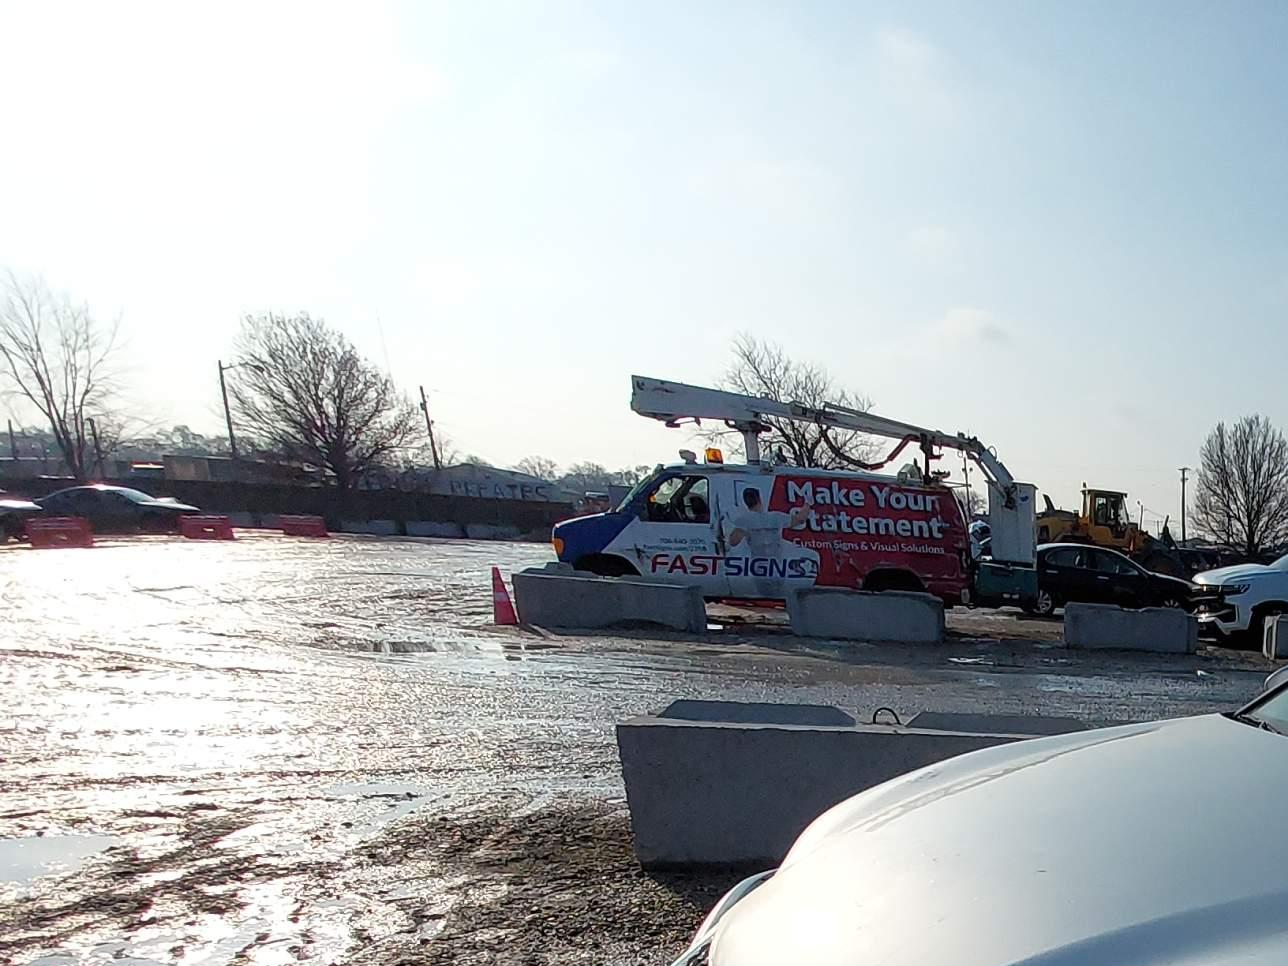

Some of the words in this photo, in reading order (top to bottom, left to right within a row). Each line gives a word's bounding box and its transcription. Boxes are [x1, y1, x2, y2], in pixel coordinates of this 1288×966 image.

[787, 481, 865, 506] Make
[870, 485, 938, 512] Your
[788, 507, 944, 539] Statement
[793, 537, 832, 549] Custom
[833, 540, 859, 551] Signs
[861, 541, 868, 551] &
[870, 542, 900, 552] Visual
[901, 542, 945, 555] Solutions
[651, 554, 817, 579] FASTSIGNS
